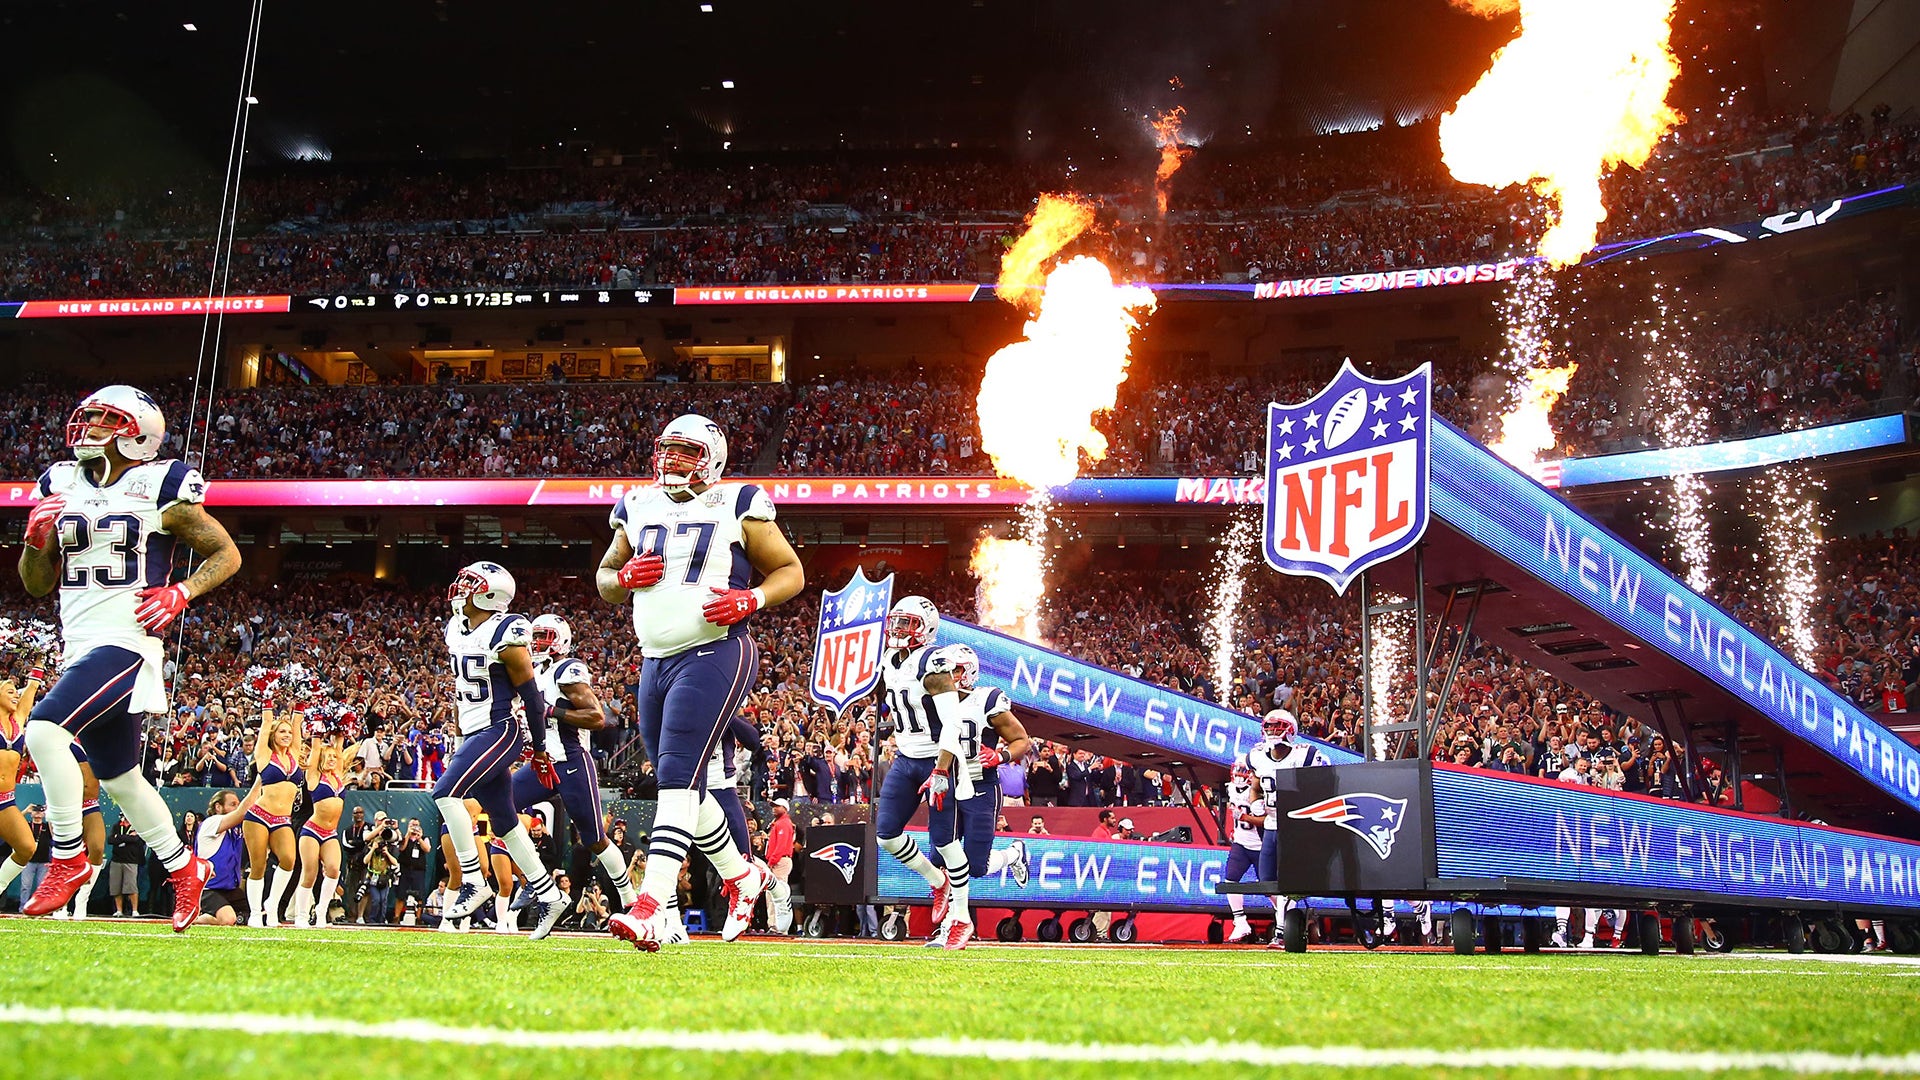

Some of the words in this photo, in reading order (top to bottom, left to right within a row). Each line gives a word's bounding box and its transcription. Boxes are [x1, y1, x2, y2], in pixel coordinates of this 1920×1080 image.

[699, 290, 736, 300] NEW
[744, 288, 828, 300] ENGLAND
[837, 287, 928, 299] PATRIOTS
[1253, 277, 1332, 299] MAKE
[1338, 270, 1417, 291] SOME
[1421, 262, 1519, 286] NOISE
[58, 303, 92, 313] NEW
[99, 301, 174, 312] ENGLAND
[181, 299, 265, 311] PATRIOTS
[334, 295, 348, 309] 0
[367, 296, 376, 307] 3
[416, 293, 430, 307] 0
[449, 294, 458, 305] 3
[463, 292, 513, 307] 17:35
[542, 291, 550, 303] 1
[832, 482, 991, 499] PATRIOTS
[1175, 478, 1265, 504] MAK
[1280, 451, 1409, 558] NFL
[58, 512, 143, 589] 23
[1544, 512, 1642, 615] NEW
[1664, 592, 1818, 731] ENGLAND
[818, 629, 873, 695] NFL
[1011, 655, 1121, 721] NEW
[1144, 698, 1246, 759] ENGL
[1546, 757, 1562, 773] 12
[1556, 808, 1653, 874] NEW
[1676, 823, 1829, 888] ENGLAND
